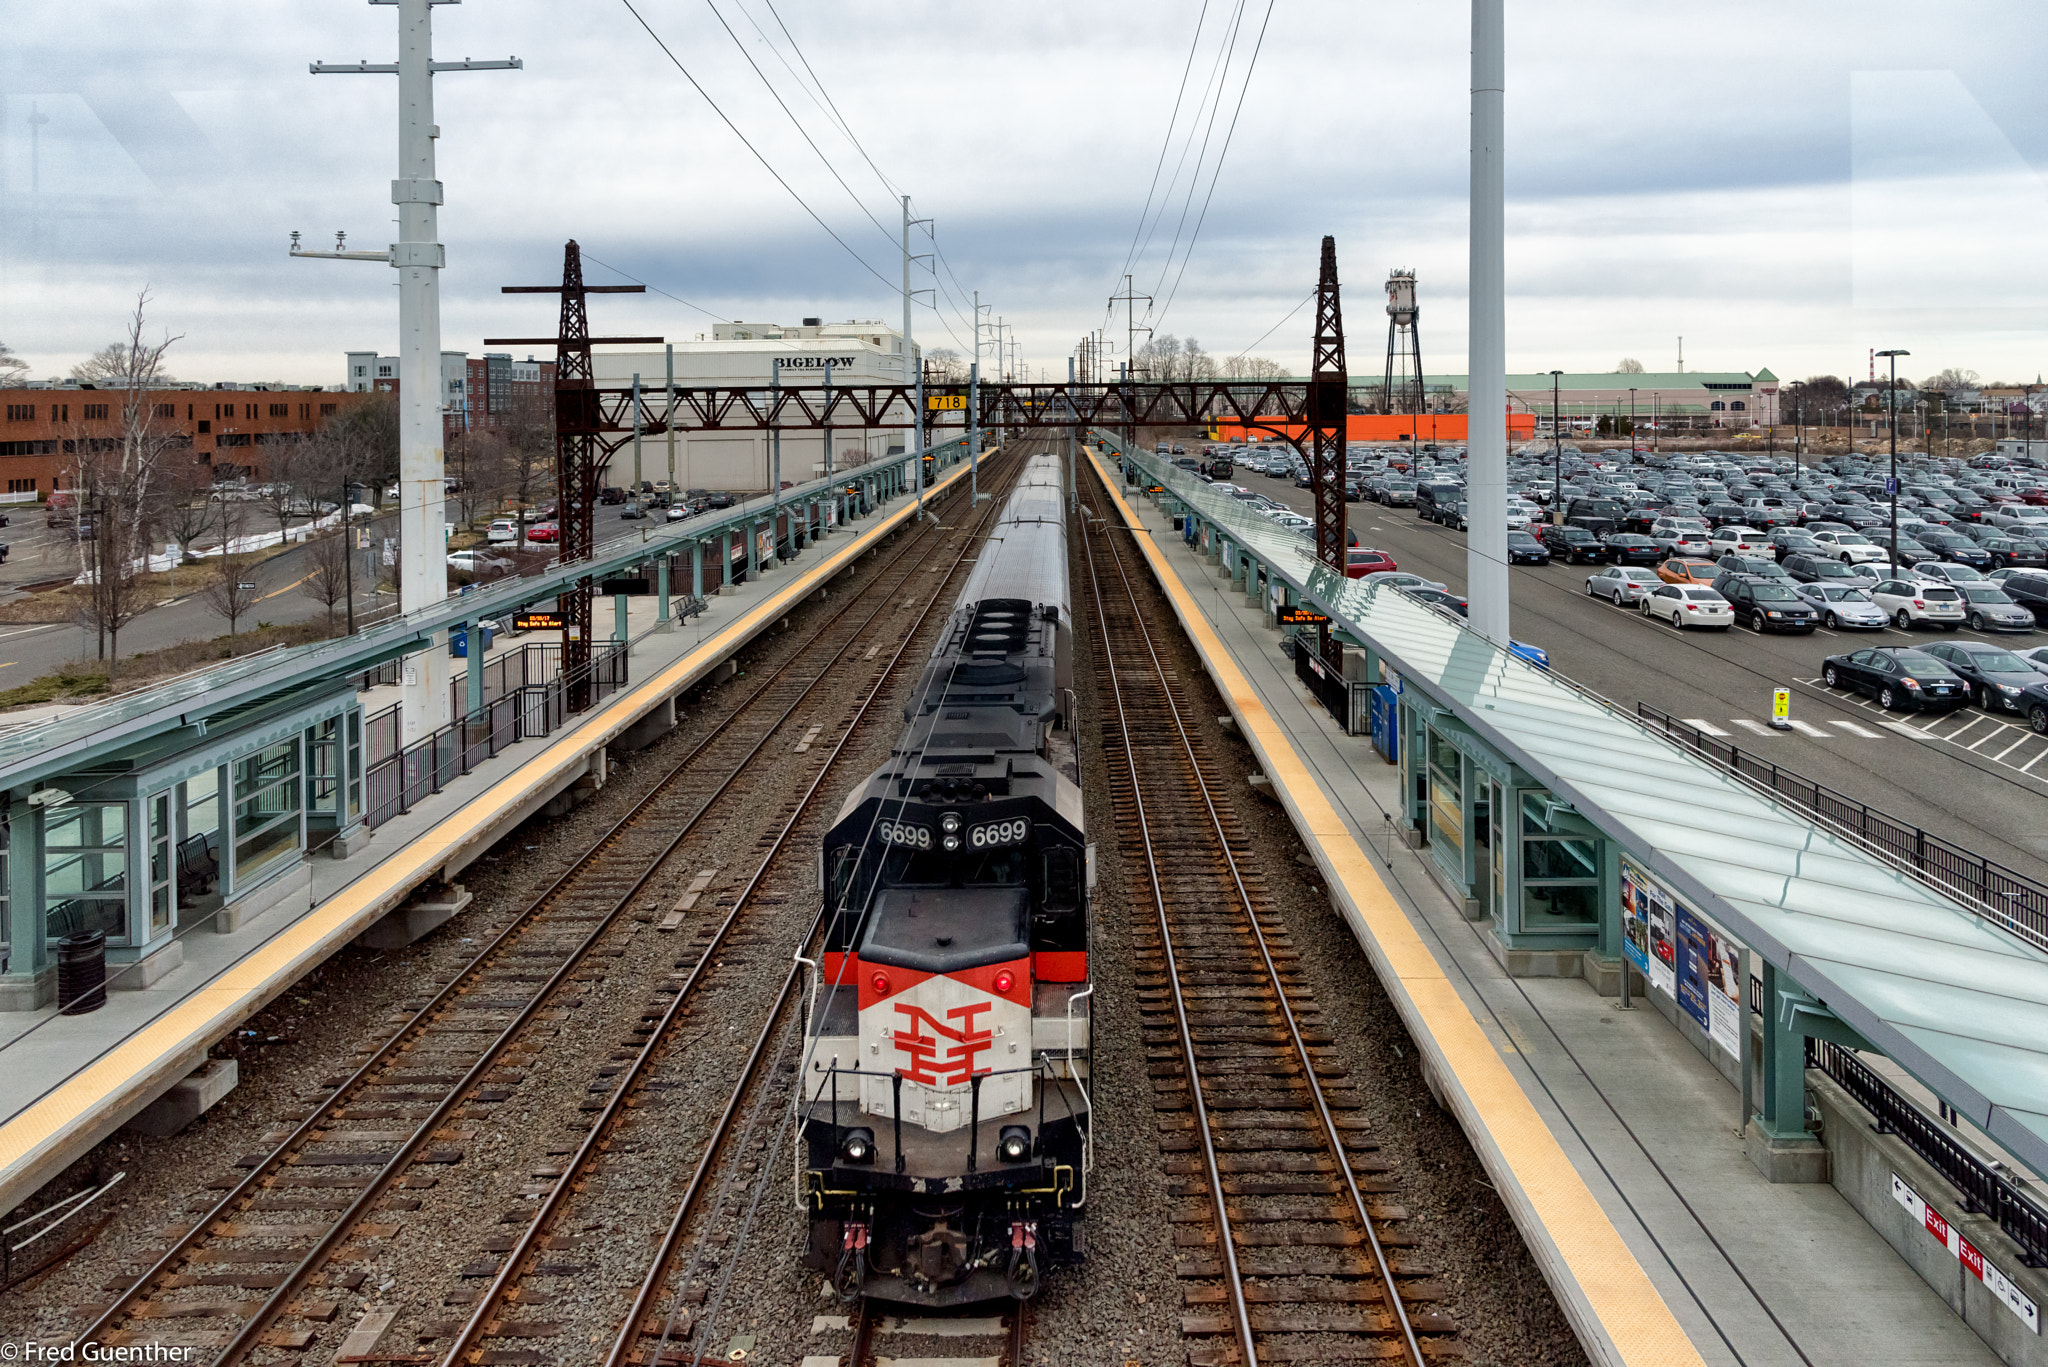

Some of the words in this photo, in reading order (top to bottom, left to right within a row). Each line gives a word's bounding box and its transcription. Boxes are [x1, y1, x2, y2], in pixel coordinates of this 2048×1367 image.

[773, 357, 856, 368] BIGELOW
[935, 397, 960, 408] 718
[880, 822, 930, 847] 6699
[972, 820, 1026, 847] 6699
[1926, 1208, 1946, 1238] Exit
[1960, 1240, 1981, 1271] Exit
